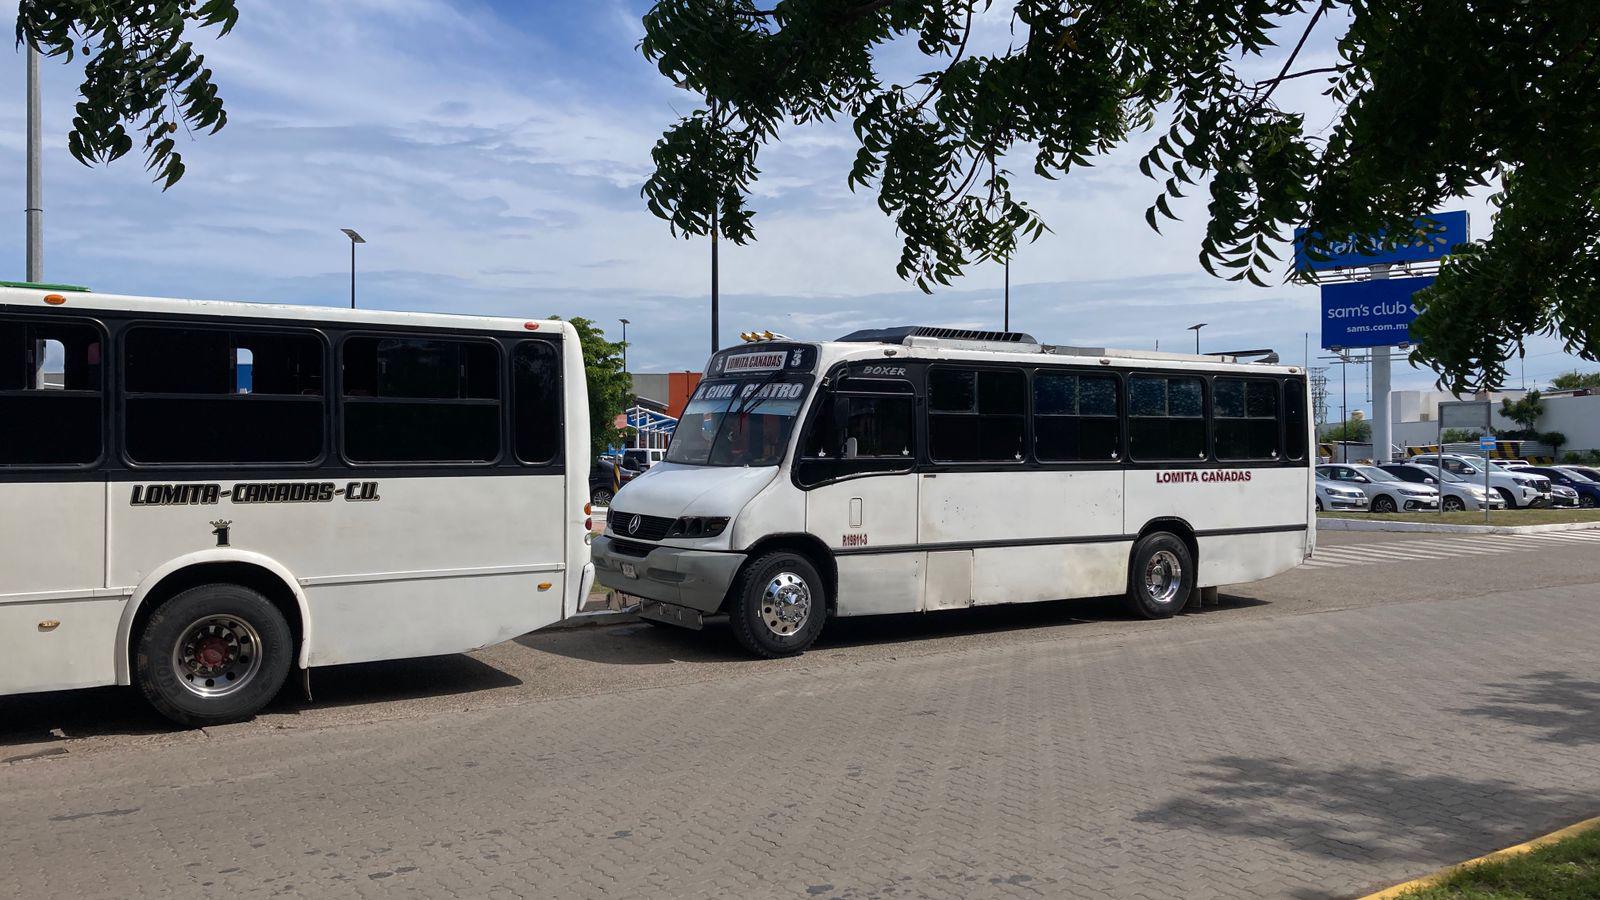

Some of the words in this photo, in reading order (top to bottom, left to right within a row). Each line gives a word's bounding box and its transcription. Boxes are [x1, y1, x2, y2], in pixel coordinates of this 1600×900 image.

[1327, 304, 1370, 319] sam's
[1372, 301, 1407, 316] club
[727, 356, 749, 369] LOMITA
[790, 353, 802, 367] 3
[863, 366, 906, 376] BOXER
[705, 384, 737, 399] CIVIL
[740, 383, 804, 399] CNTRO
[1156, 472, 1199, 483] LOMITA
[1201, 469, 1252, 482] CAÑADAS
[212, 526, 231, 547] 1
